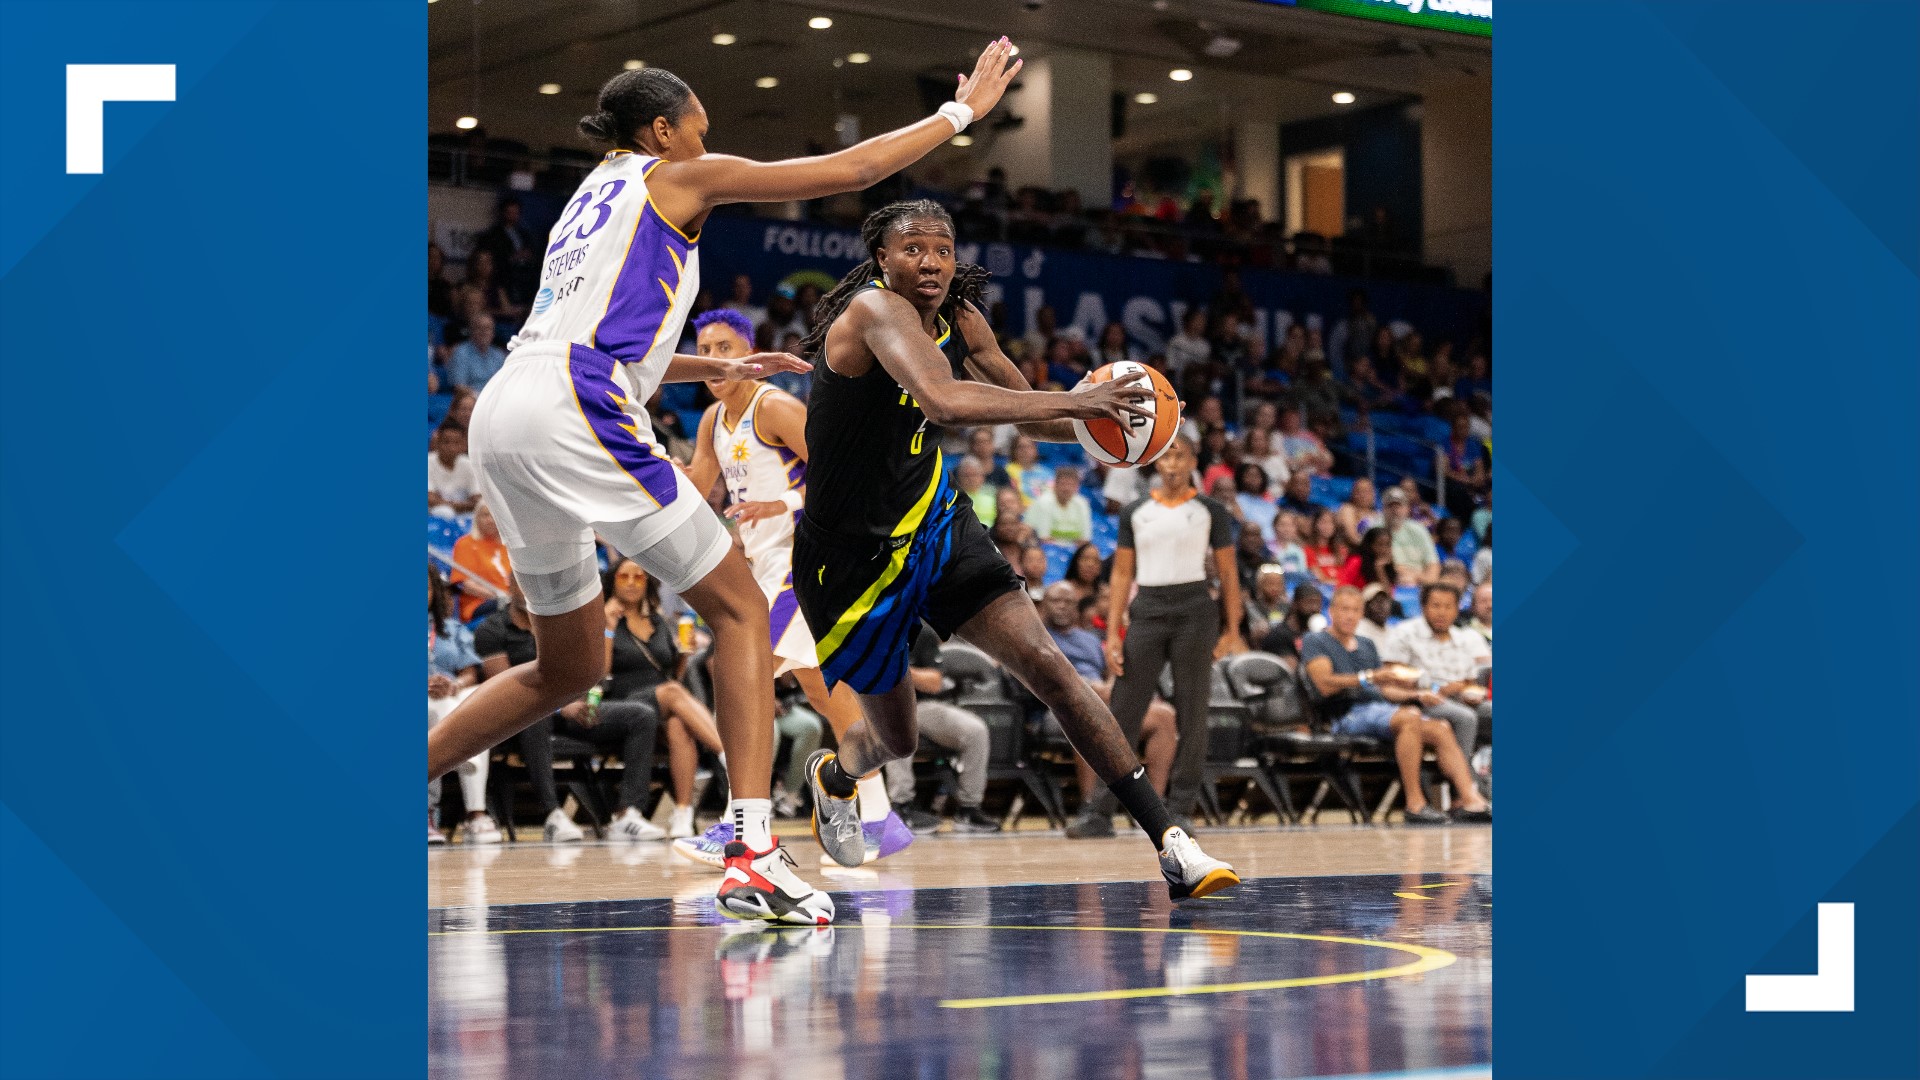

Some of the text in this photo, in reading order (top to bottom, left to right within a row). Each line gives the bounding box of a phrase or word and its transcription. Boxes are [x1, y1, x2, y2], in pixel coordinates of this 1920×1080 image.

[547, 179, 627, 257] 23
[545, 243, 590, 281] STEVENS
[722, 464, 748, 482] PARKS
